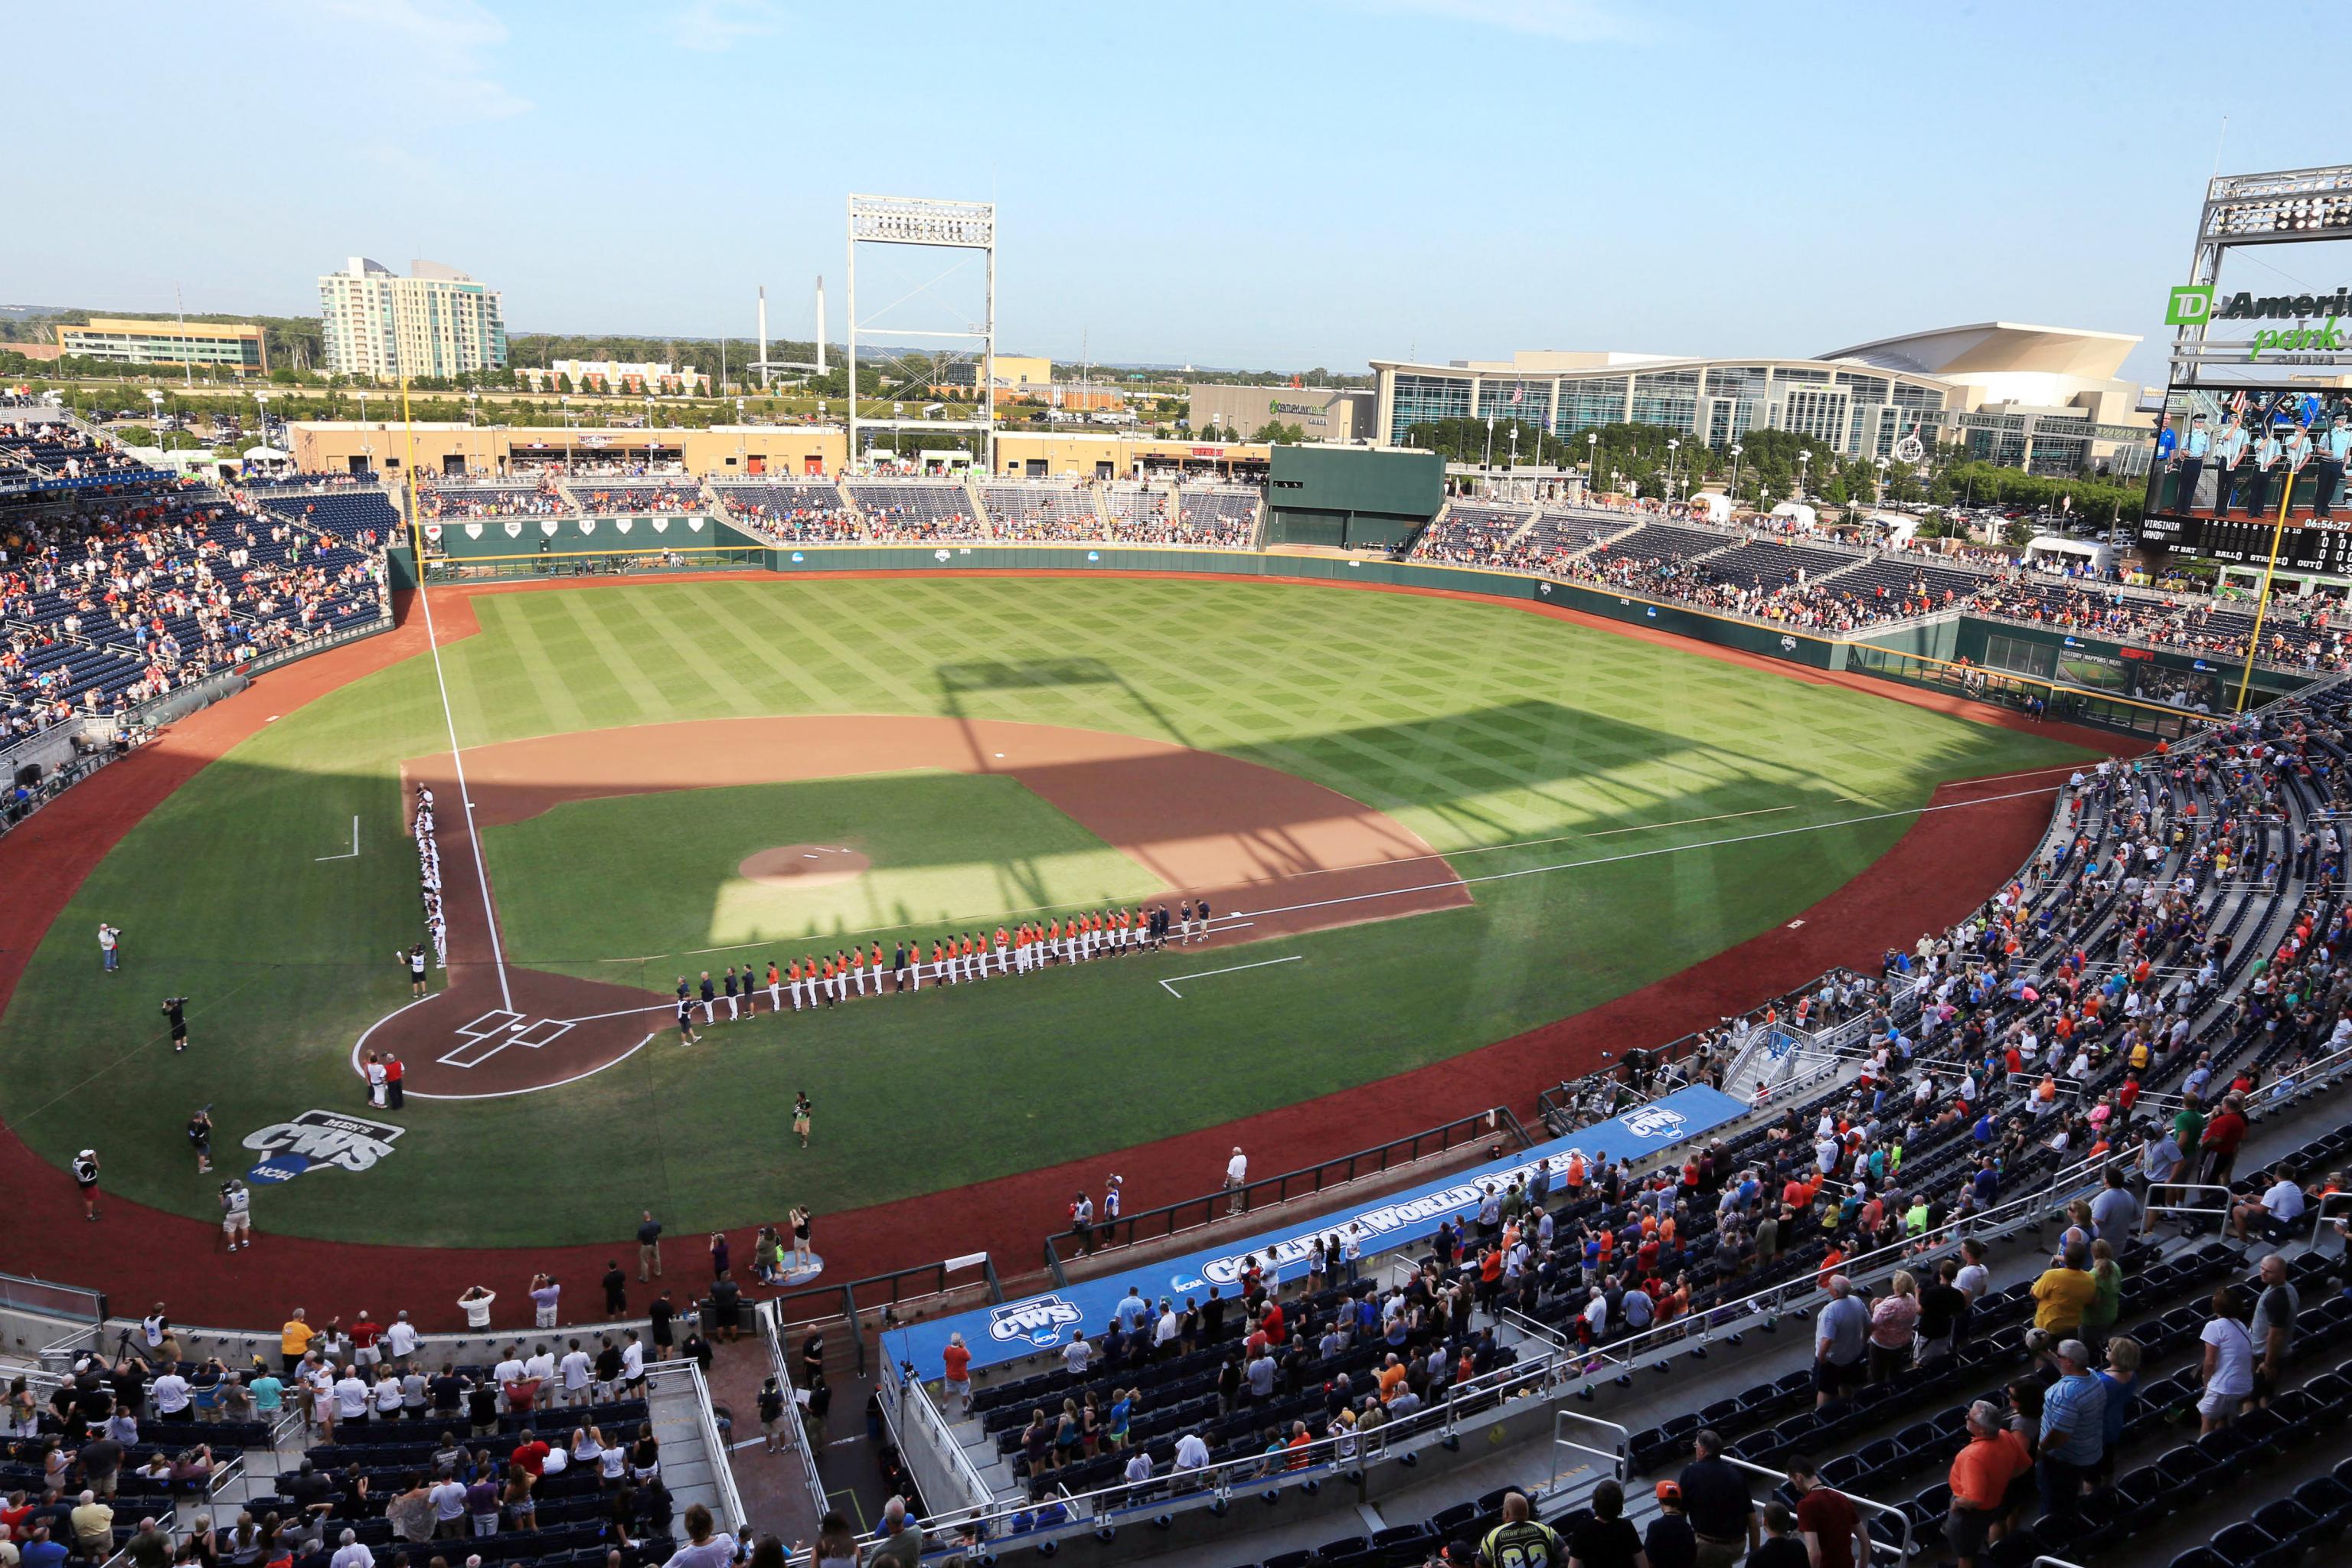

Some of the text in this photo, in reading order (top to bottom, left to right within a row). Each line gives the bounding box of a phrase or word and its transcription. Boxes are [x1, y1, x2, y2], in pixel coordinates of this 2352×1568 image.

[2174, 293, 2207, 318] TD
[2249, 315, 2344, 361] park
[2305, 518, 2351, 531] 06:56:27
[2144, 519, 2347, 549] VIRGINIA 0 0
[2142, 530, 2165, 541] VANDY
[2318, 549, 2327, 560] 0
[2336, 550, 2344, 561] 0
[2215, 550, 2243, 561] BALL 0
[2282, 557, 2288, 567] 0
[2315, 560, 2323, 570] 0
[2062, 650, 2082, 658] HISTORY
[2084, 654, 2106, 664] HAPPENS
[2119, 647, 2154, 662] ESPN
[322, 1119, 374, 1134] MEN'S
[1630, 1111, 1683, 1136] CWS
[242, 1122, 395, 1171] CWS
[252, 1166, 296, 1181] NCAA
[1360, 1185, 1483, 1231] WORLD
[1173, 1278, 1206, 1294] NCAA
[992, 1304, 1078, 1338] CWS
[1034, 1332, 1060, 1344] NCAA
